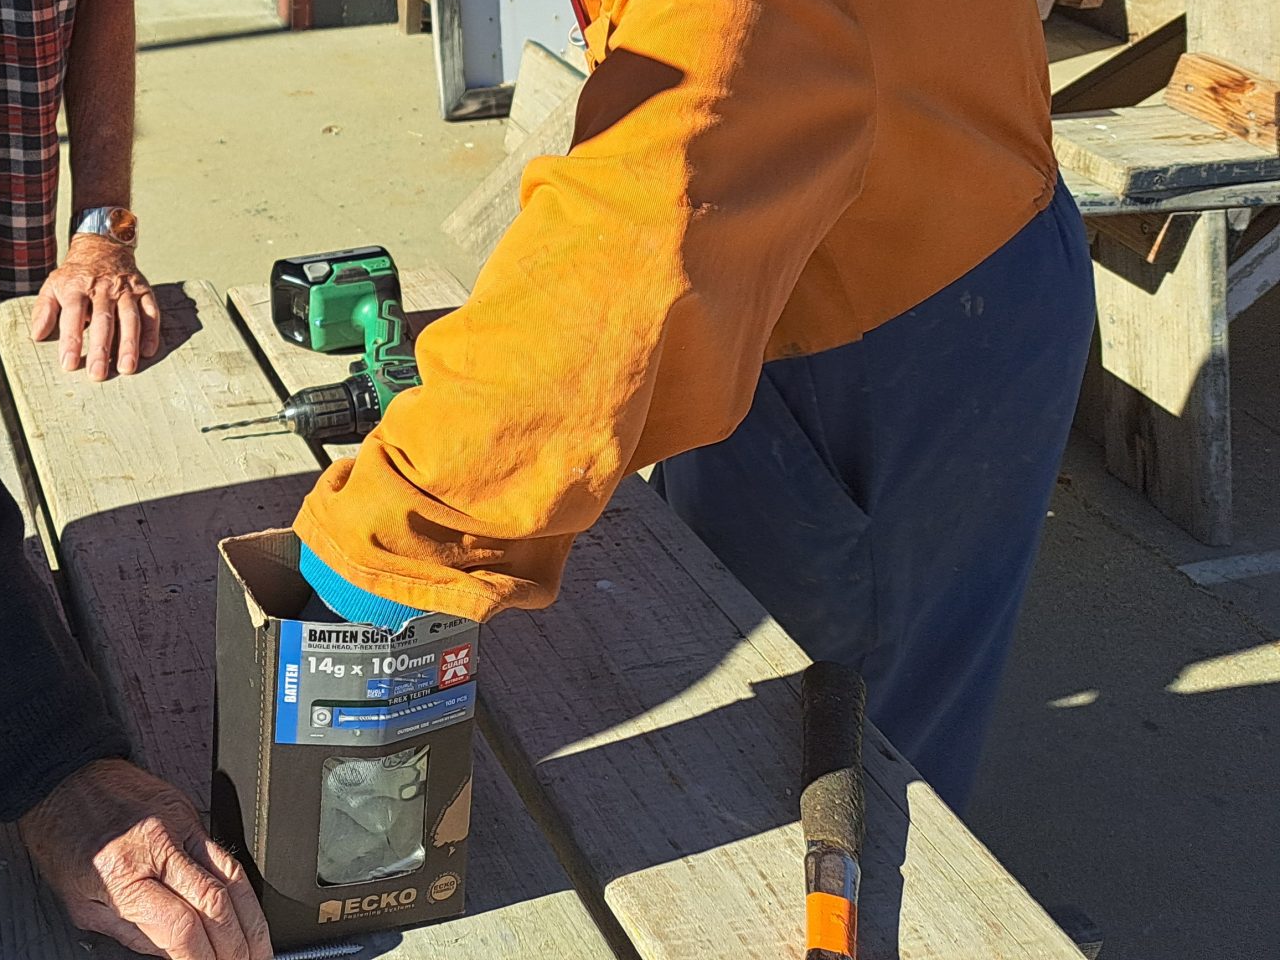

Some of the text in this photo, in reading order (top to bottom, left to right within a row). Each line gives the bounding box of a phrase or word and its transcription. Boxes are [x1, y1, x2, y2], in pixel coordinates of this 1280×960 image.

[309, 629, 359, 644] BATTEN
[308, 653, 435, 678] 14g x 100mm
[442, 657, 469, 671] GUARD
[284, 663, 299, 703] BATTEN
[389, 696, 408, 706] T-REX
[410, 689, 431, 700] TEETH
[446, 695, 468, 707] 100 PCS
[433, 880, 456, 891] ECKO
[344, 888, 417, 914] ECKO
[344, 903, 415, 920] Fastening Systems
